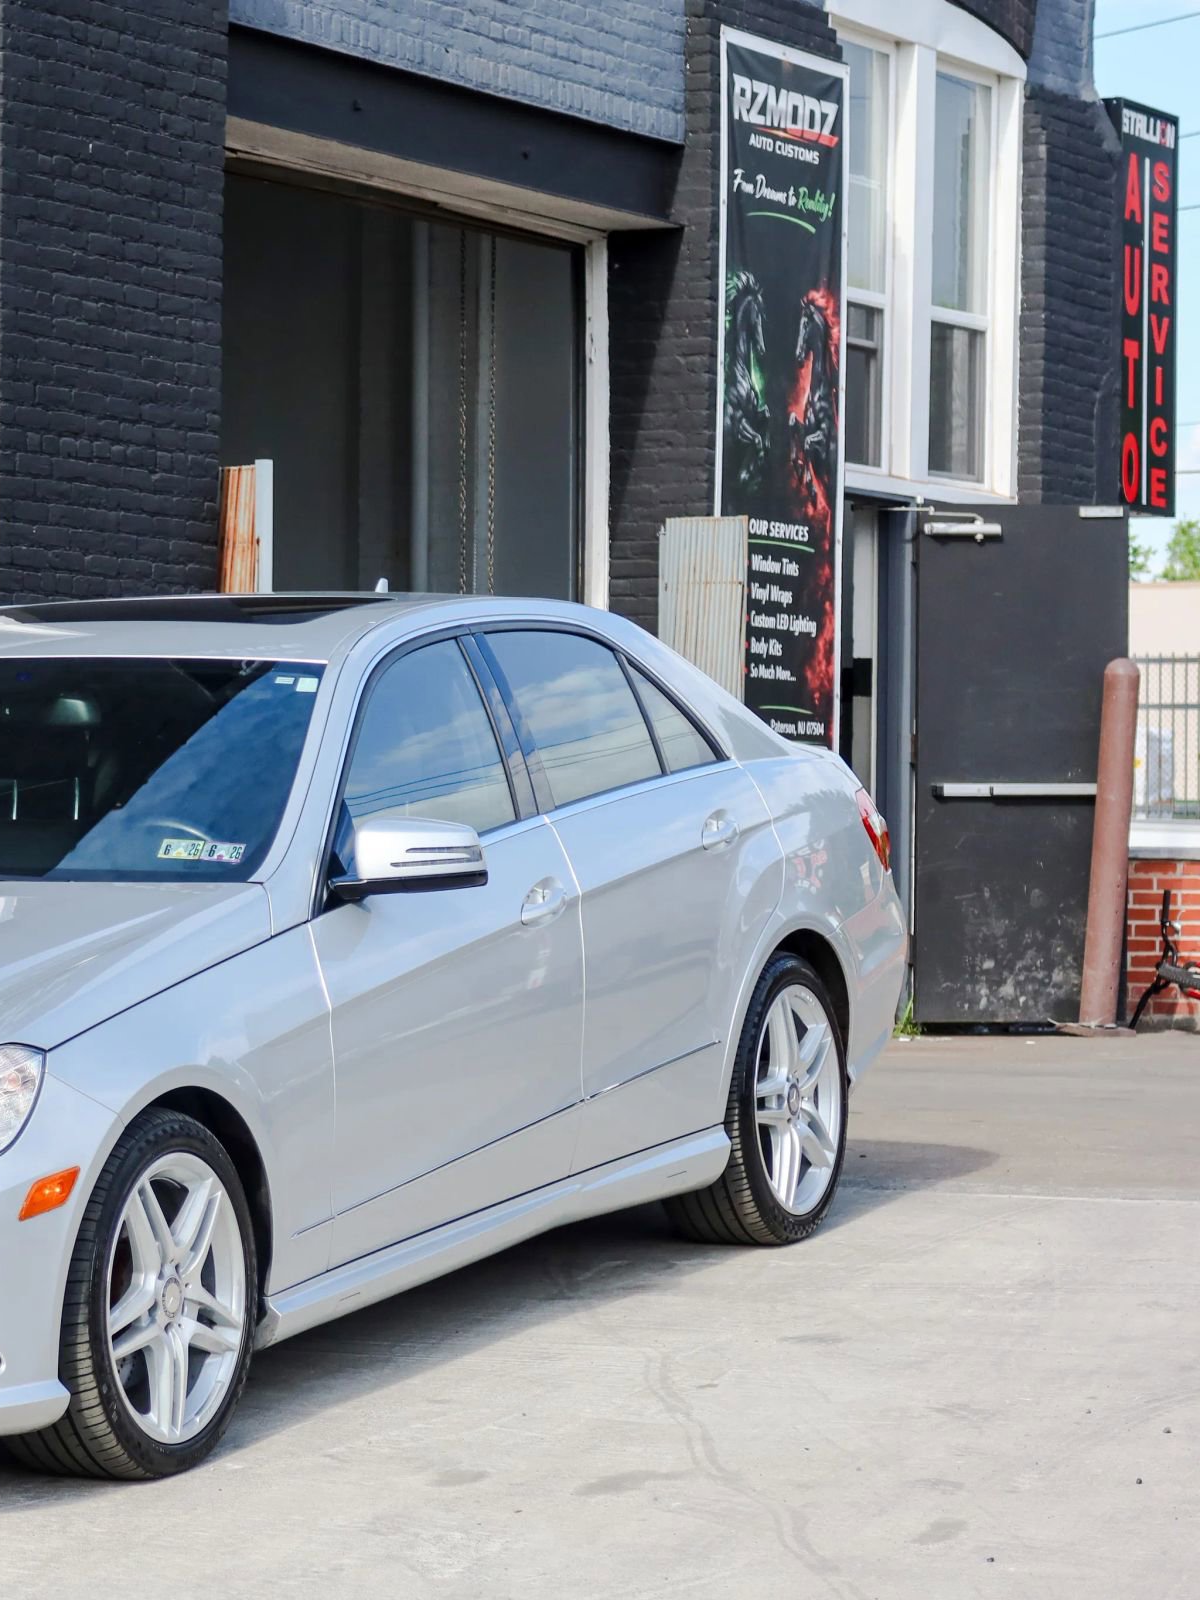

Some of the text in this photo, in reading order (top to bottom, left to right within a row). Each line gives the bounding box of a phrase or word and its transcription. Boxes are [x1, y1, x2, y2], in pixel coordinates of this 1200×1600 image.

[733, 74, 839, 147] RZMODZ
[1122, 107, 1175, 149] STALLION
[749, 133, 819, 165] AUTO CUSTOMS
[733, 168, 835, 222] From Dreams to Reality!
[1122, 152, 1142, 503] AUTO
[1150, 161, 1170, 508] SERVICE
[749, 518, 809, 542] OUR SERVICES
[751, 554, 800, 577] Window Tints
[751, 583, 793, 607] Vinyl Wraps
[751, 611, 817, 638] Custom LED Lighting
[751, 637, 782, 659] Body Kits
[750, 666, 797, 682] So Much More...
[771, 719, 825, 736] Paterson, NJ 07504
[164, 843, 200, 856] 6 26
[208, 844, 242, 859] 6 26
